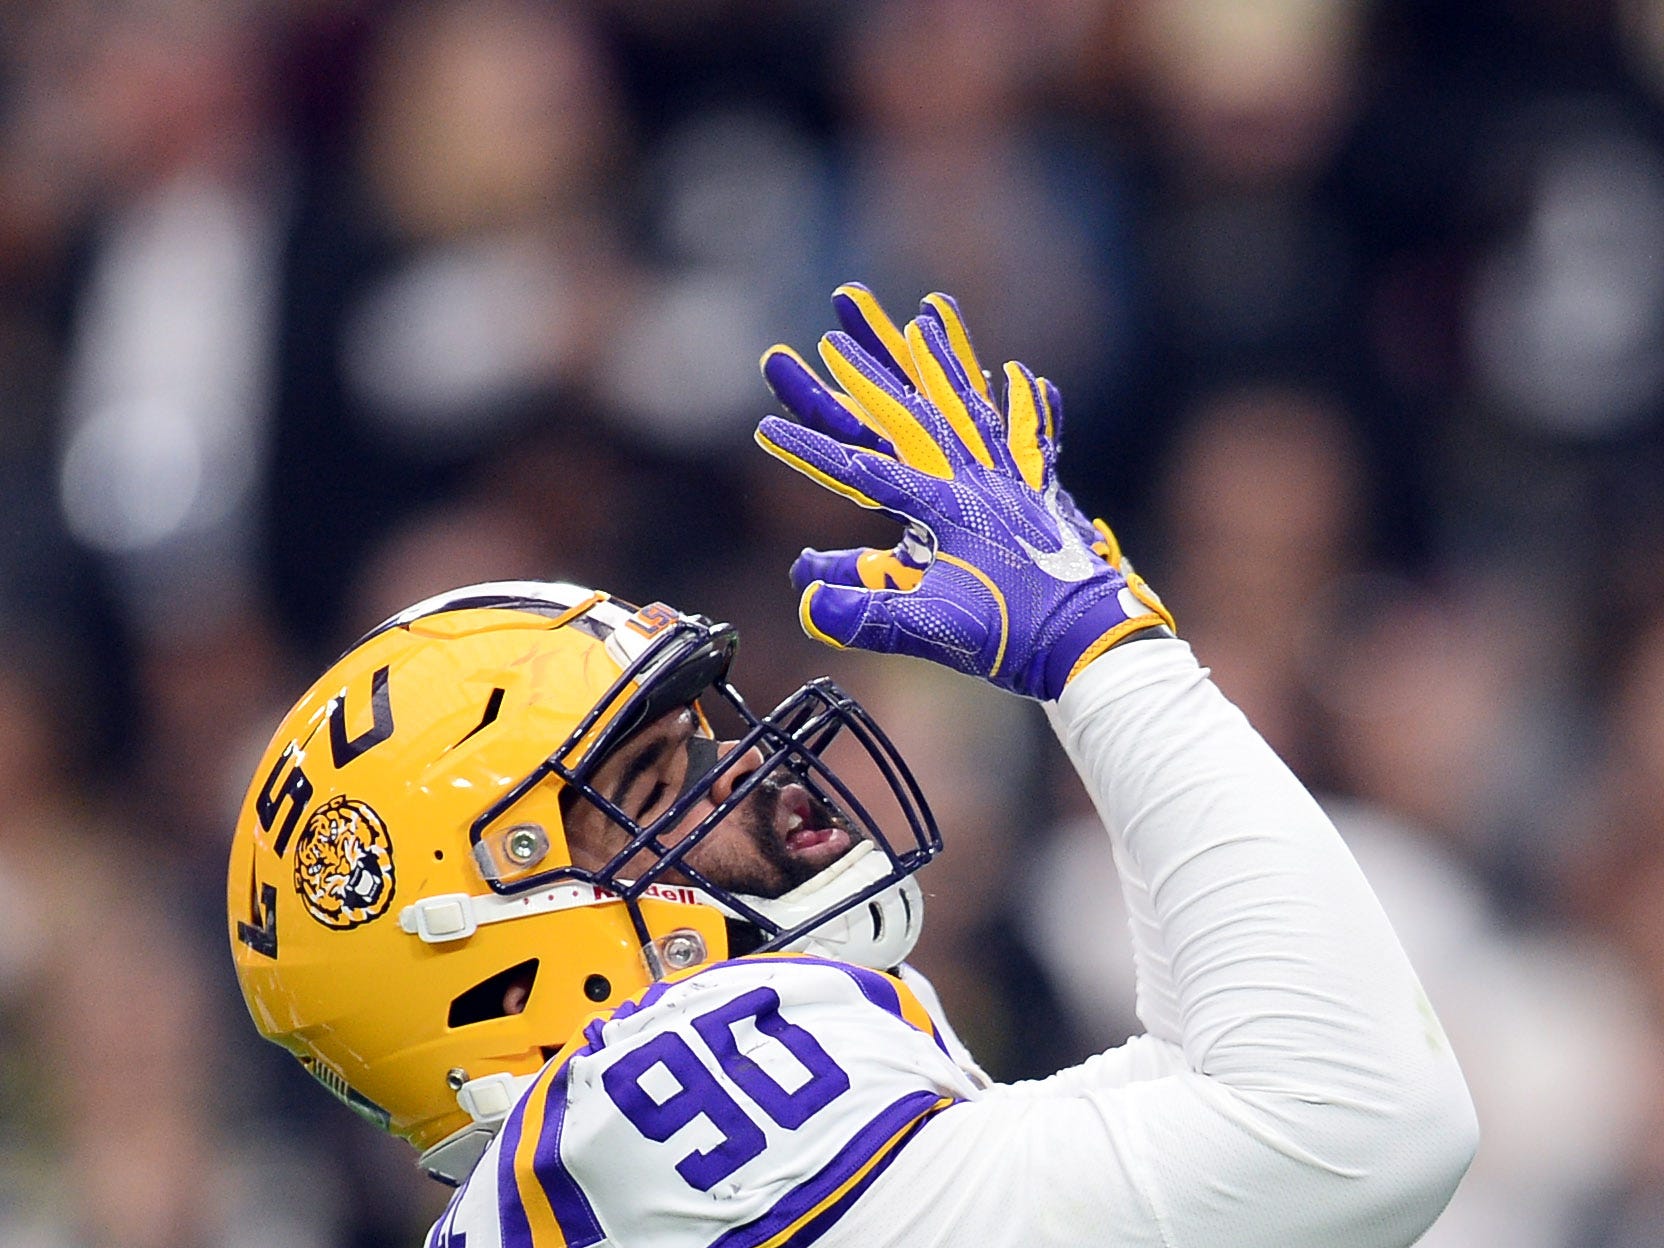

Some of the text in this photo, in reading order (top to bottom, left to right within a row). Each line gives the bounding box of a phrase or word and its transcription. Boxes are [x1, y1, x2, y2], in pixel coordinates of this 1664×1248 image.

[625, 602, 680, 640] LSU
[238, 665, 394, 960] LSU
[593, 884, 695, 904] Rdell
[601, 986, 851, 1192] 90
